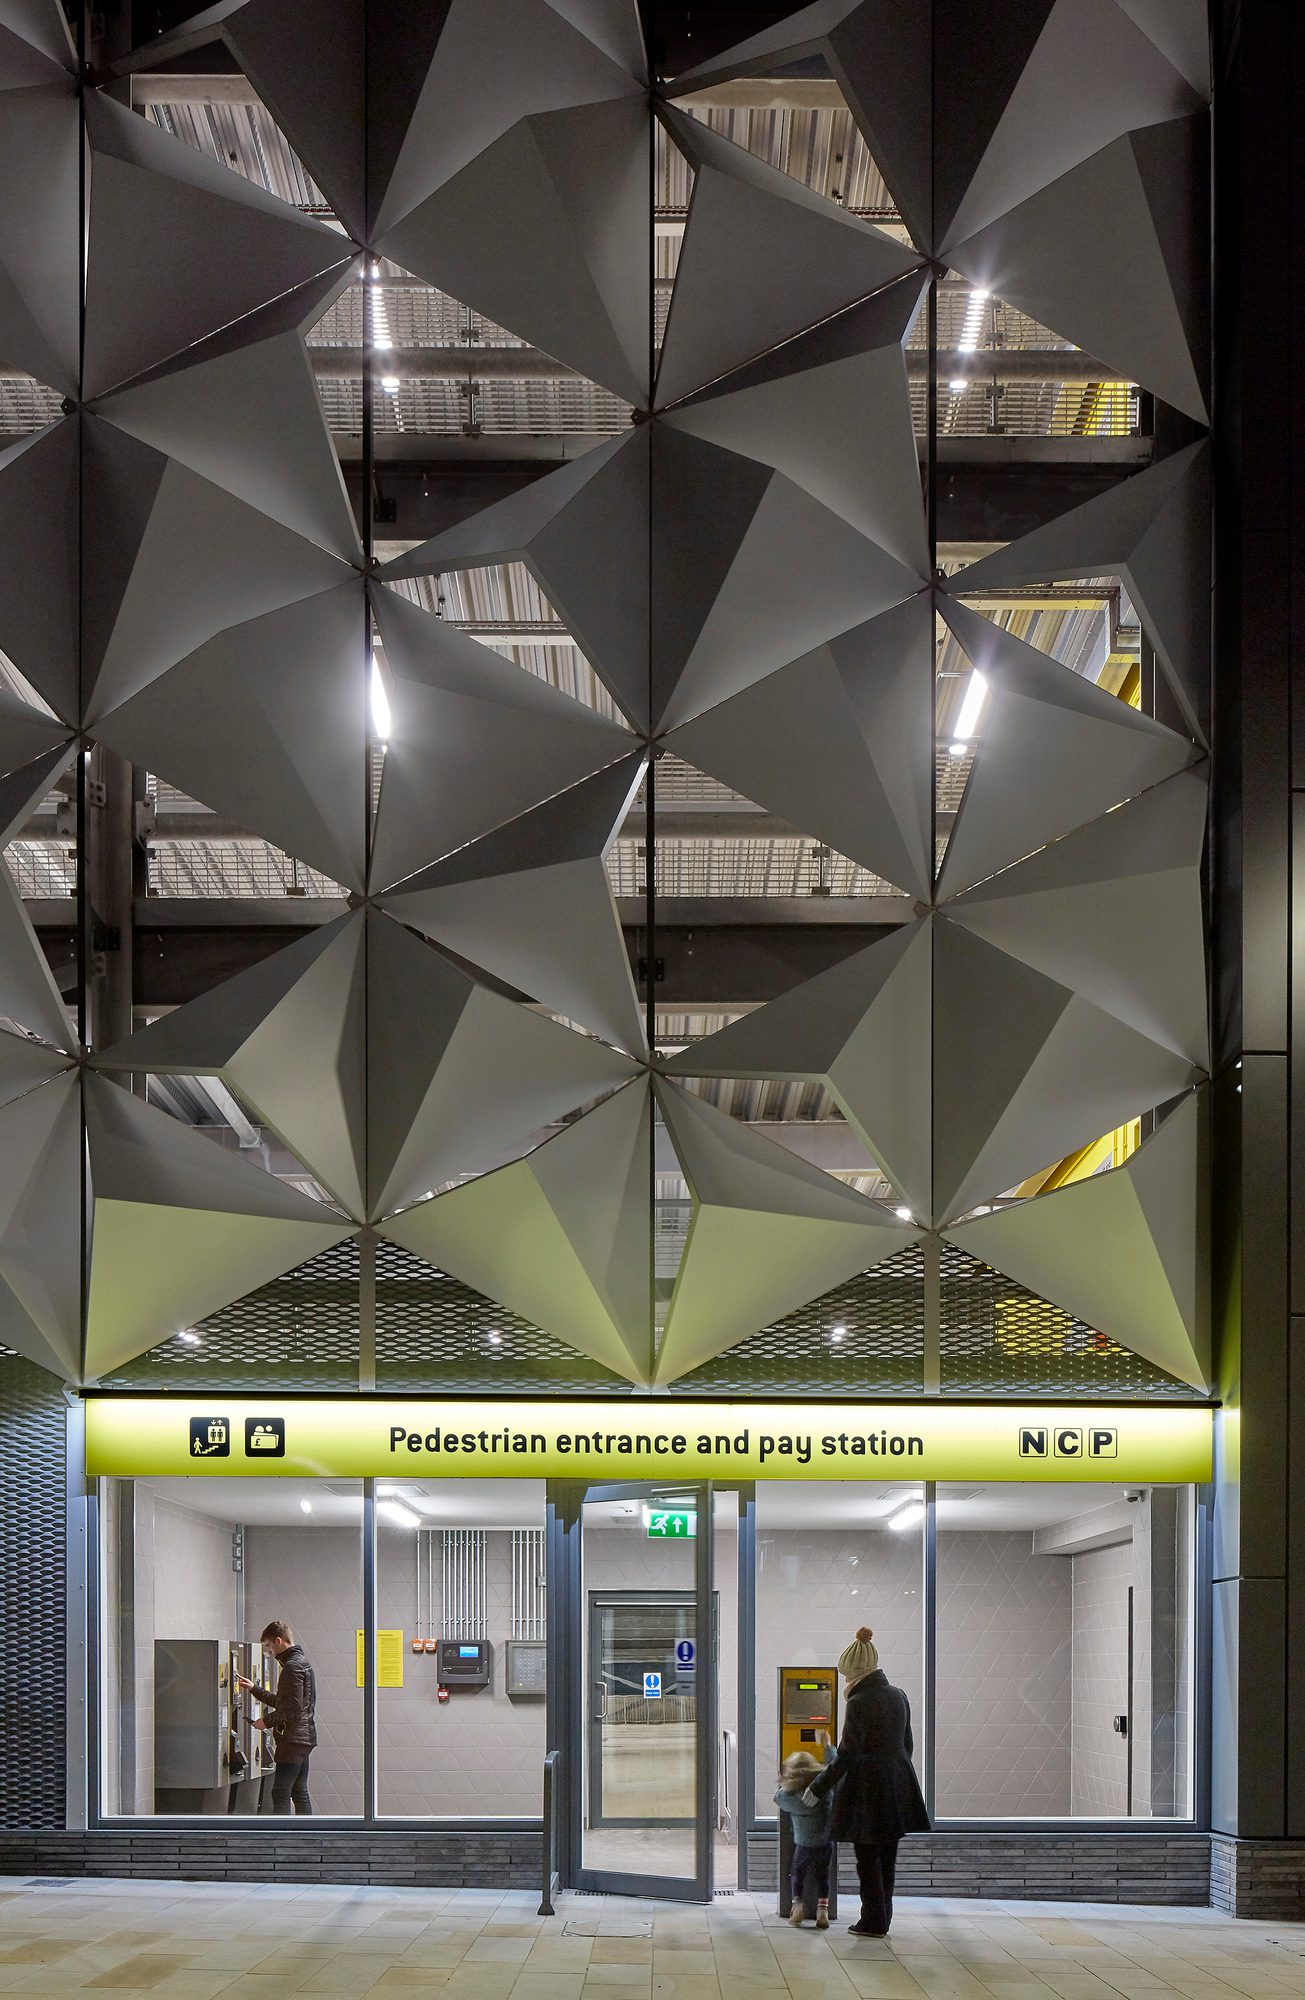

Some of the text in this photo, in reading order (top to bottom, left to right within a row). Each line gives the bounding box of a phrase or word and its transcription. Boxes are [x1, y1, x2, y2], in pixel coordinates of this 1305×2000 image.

[391, 1426, 923, 1463] Pedestrian entrance and pay station
[1021, 1429, 1115, 1457] NCP
